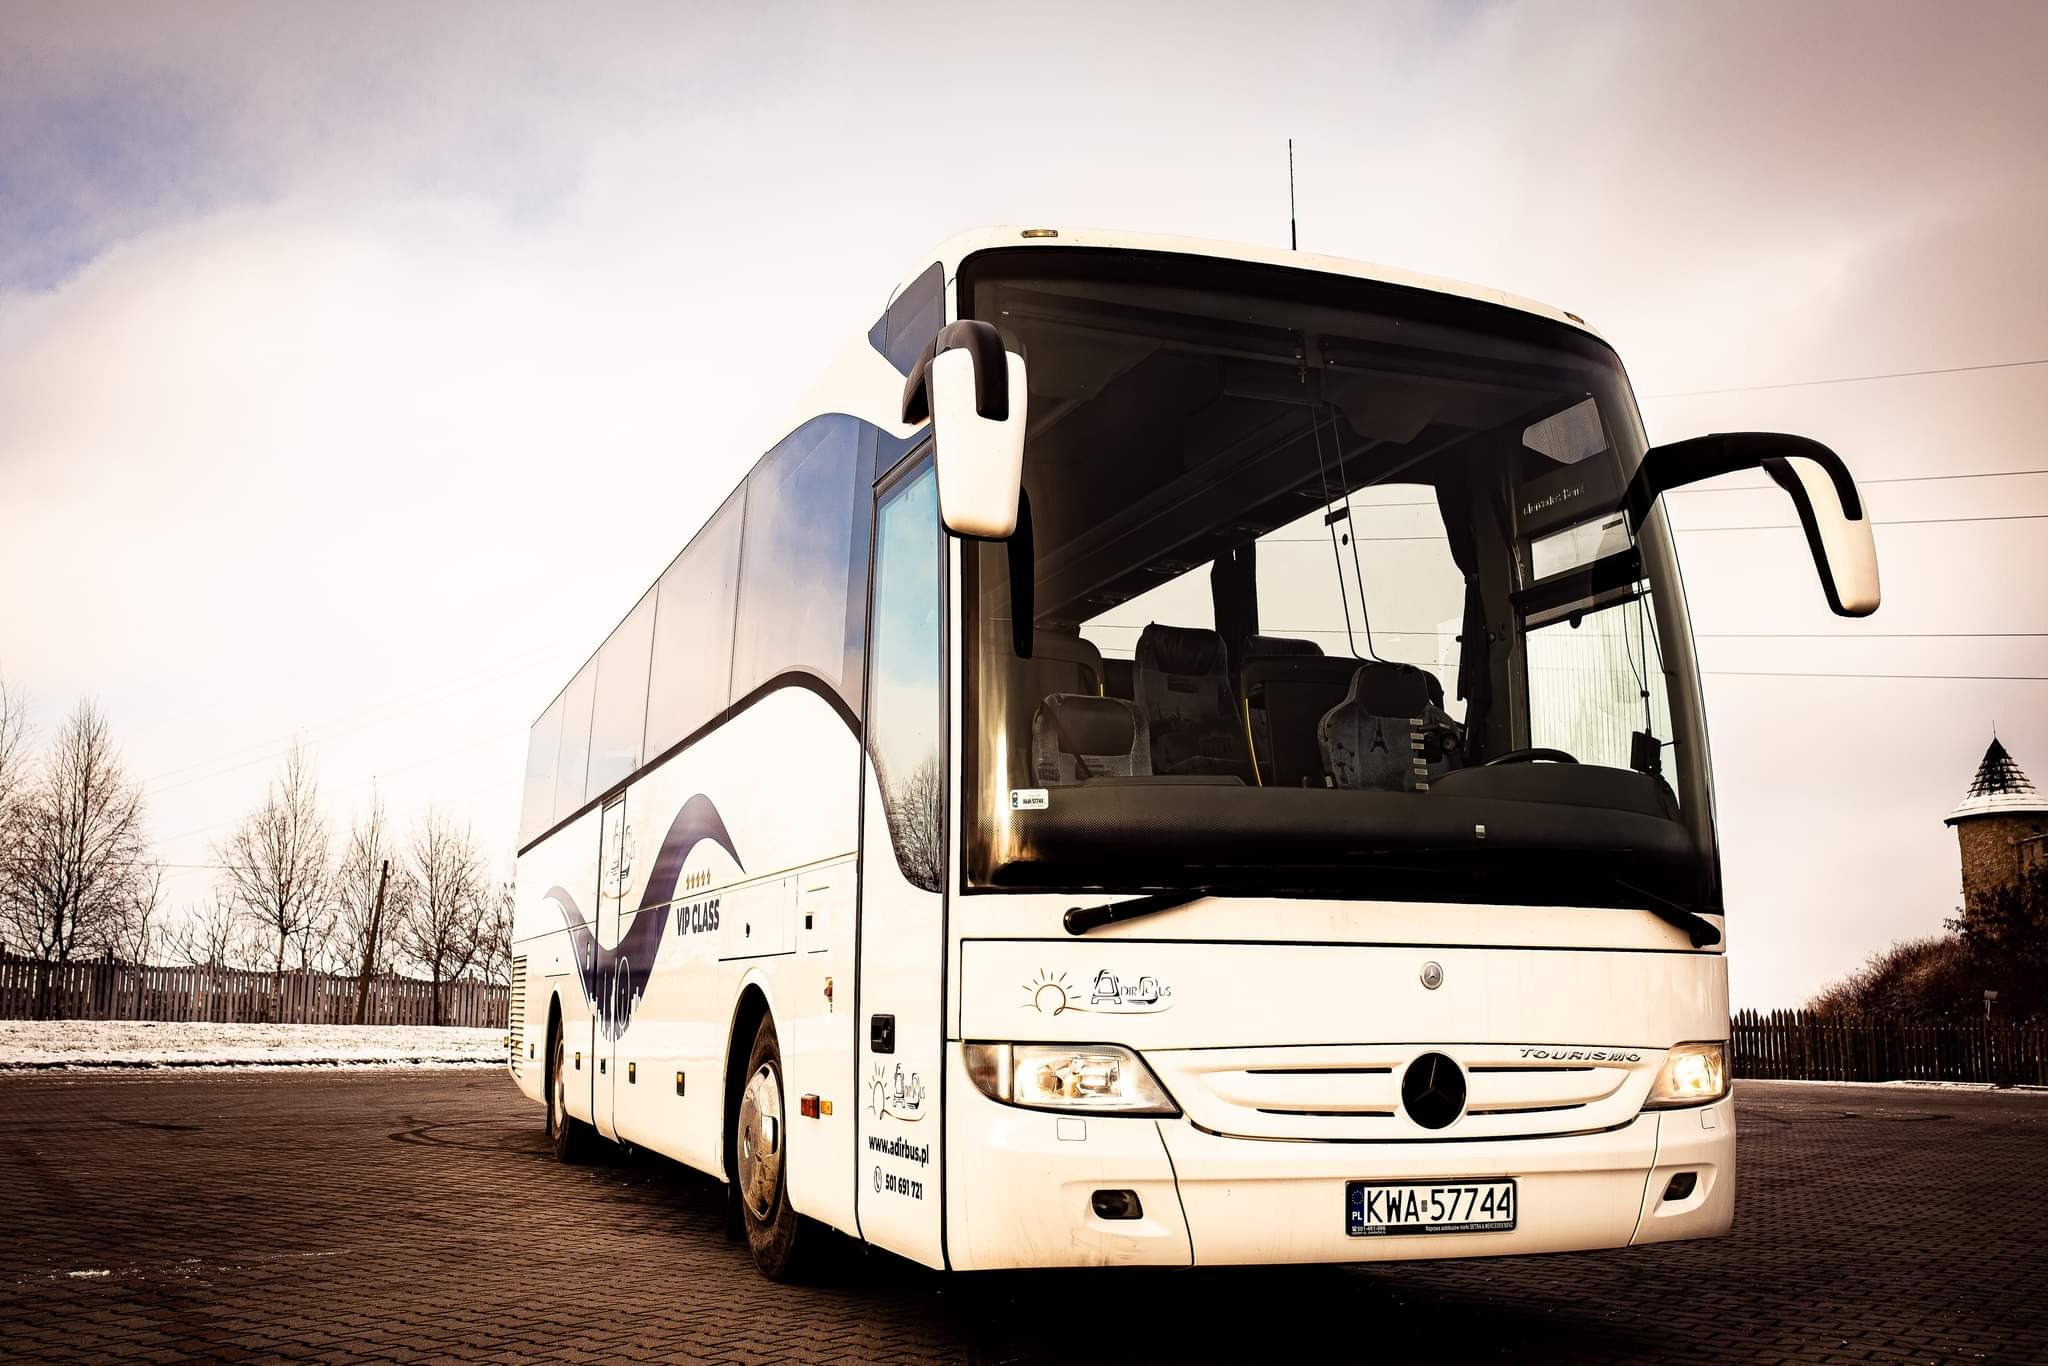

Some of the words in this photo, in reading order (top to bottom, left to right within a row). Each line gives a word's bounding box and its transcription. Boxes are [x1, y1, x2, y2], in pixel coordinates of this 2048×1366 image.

[677, 906, 690, 936] VIP
[692, 898, 720, 934] CLASS
[1520, 1048, 1641, 1062] TOURISMO
[868, 1135, 929, 1168] www.adirbus.pl
[885, 1173, 897, 1193] 501
[898, 1177, 910, 1197] 691
[911, 1180, 923, 1201] 721
[1352, 1211, 1363, 1221] PL
[1367, 1189, 1420, 1223] KWA
[1430, 1186, 1511, 1222] 57744
